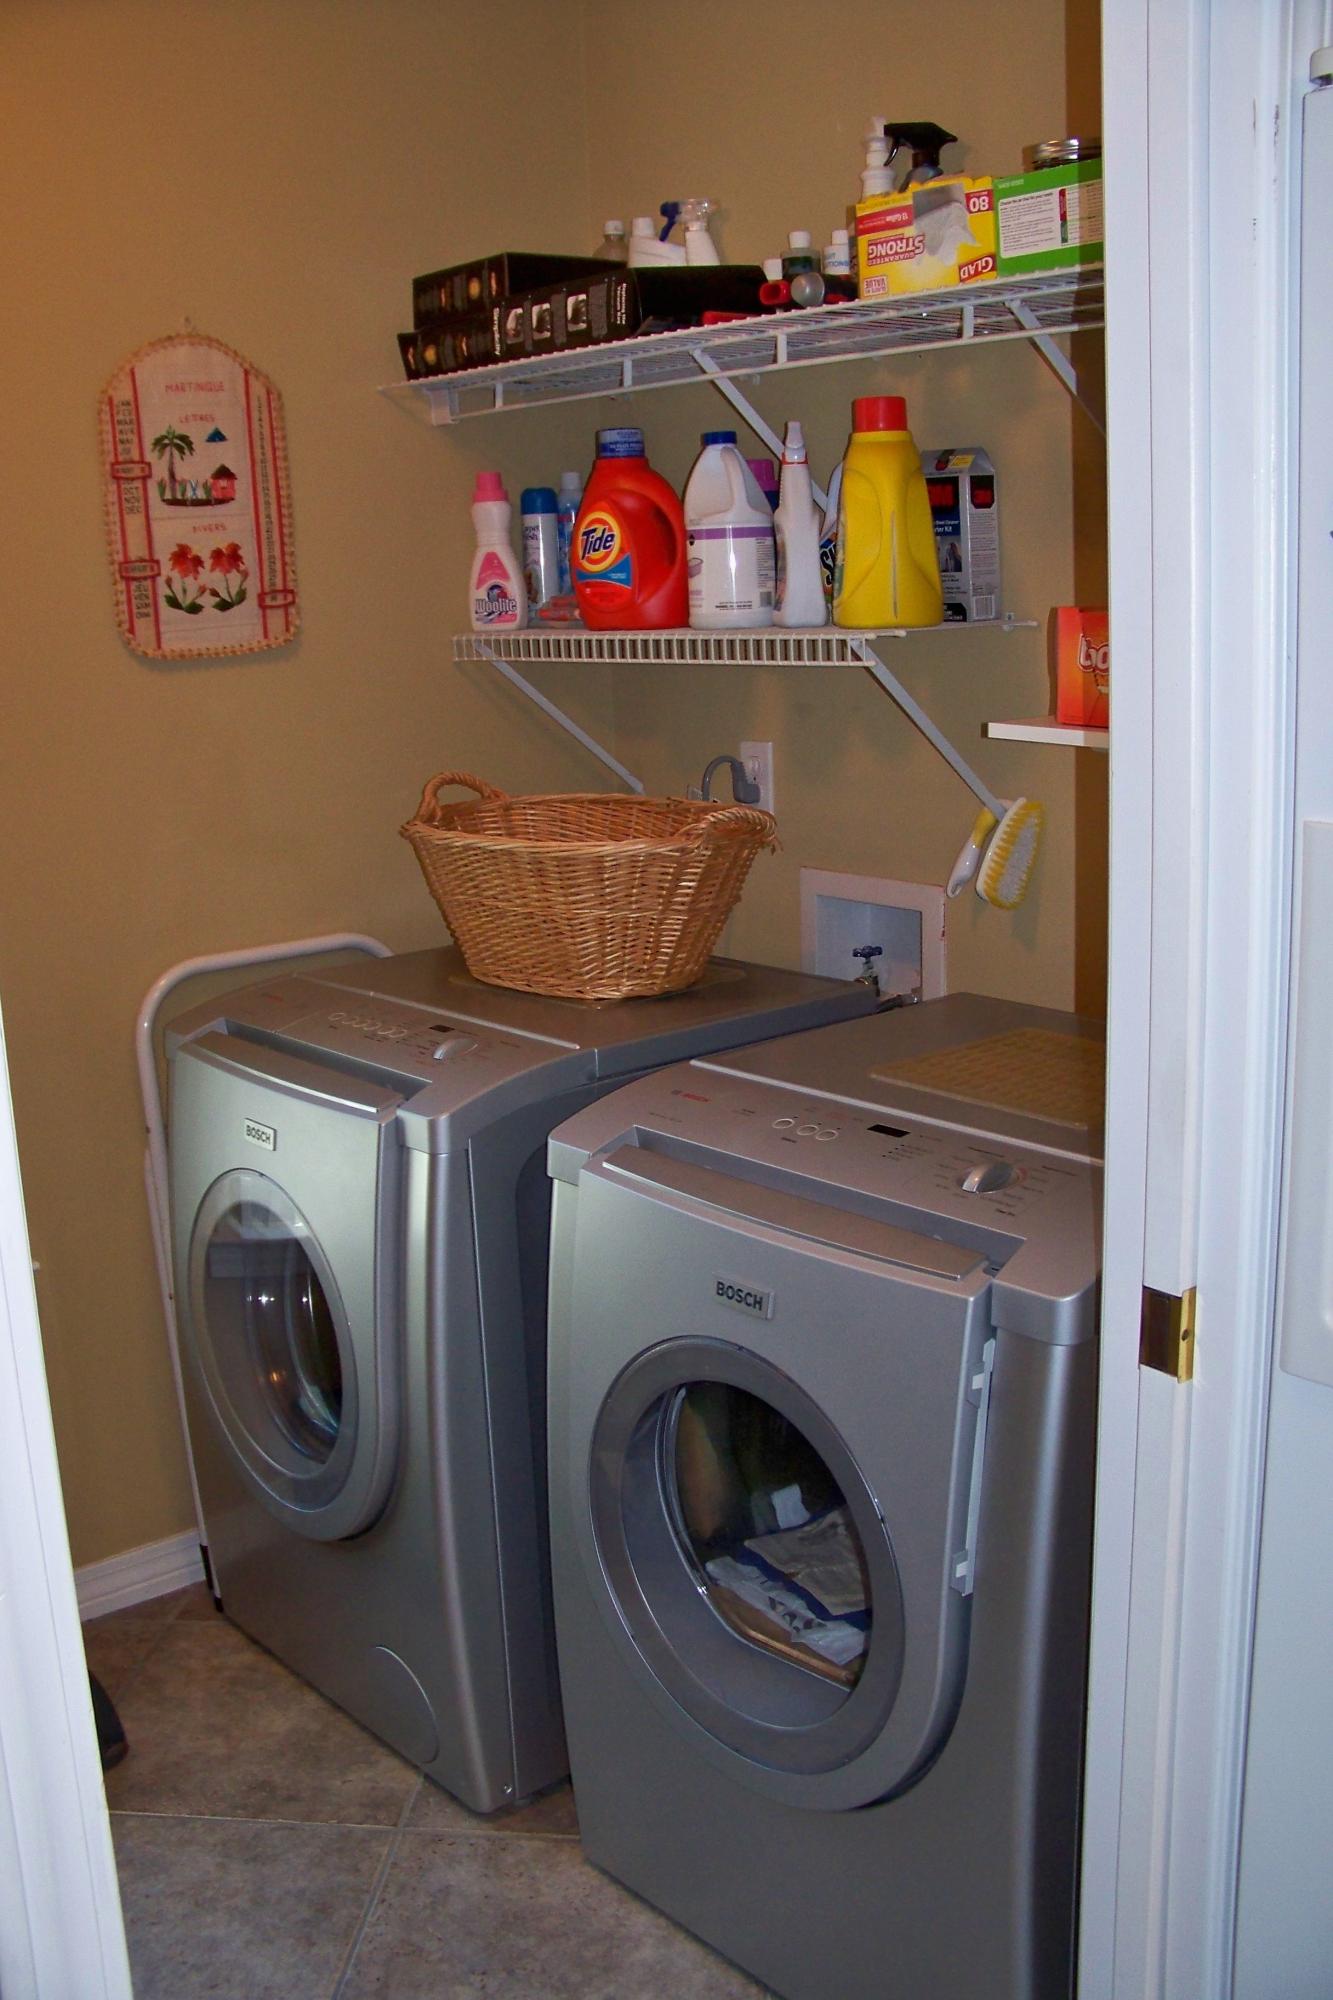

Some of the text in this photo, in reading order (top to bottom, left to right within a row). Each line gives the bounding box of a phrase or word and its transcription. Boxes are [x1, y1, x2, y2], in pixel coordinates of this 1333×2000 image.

[968, 195, 990, 213] 80
[868, 234, 925, 259] STRONG
[960, 256, 994, 279] GLAD
[581, 527, 616, 561] Tide
[474, 597, 518, 615] Woolite
[246, 1124, 271, 1145] BOSCH
[716, 1280, 764, 1311] BOSCH
